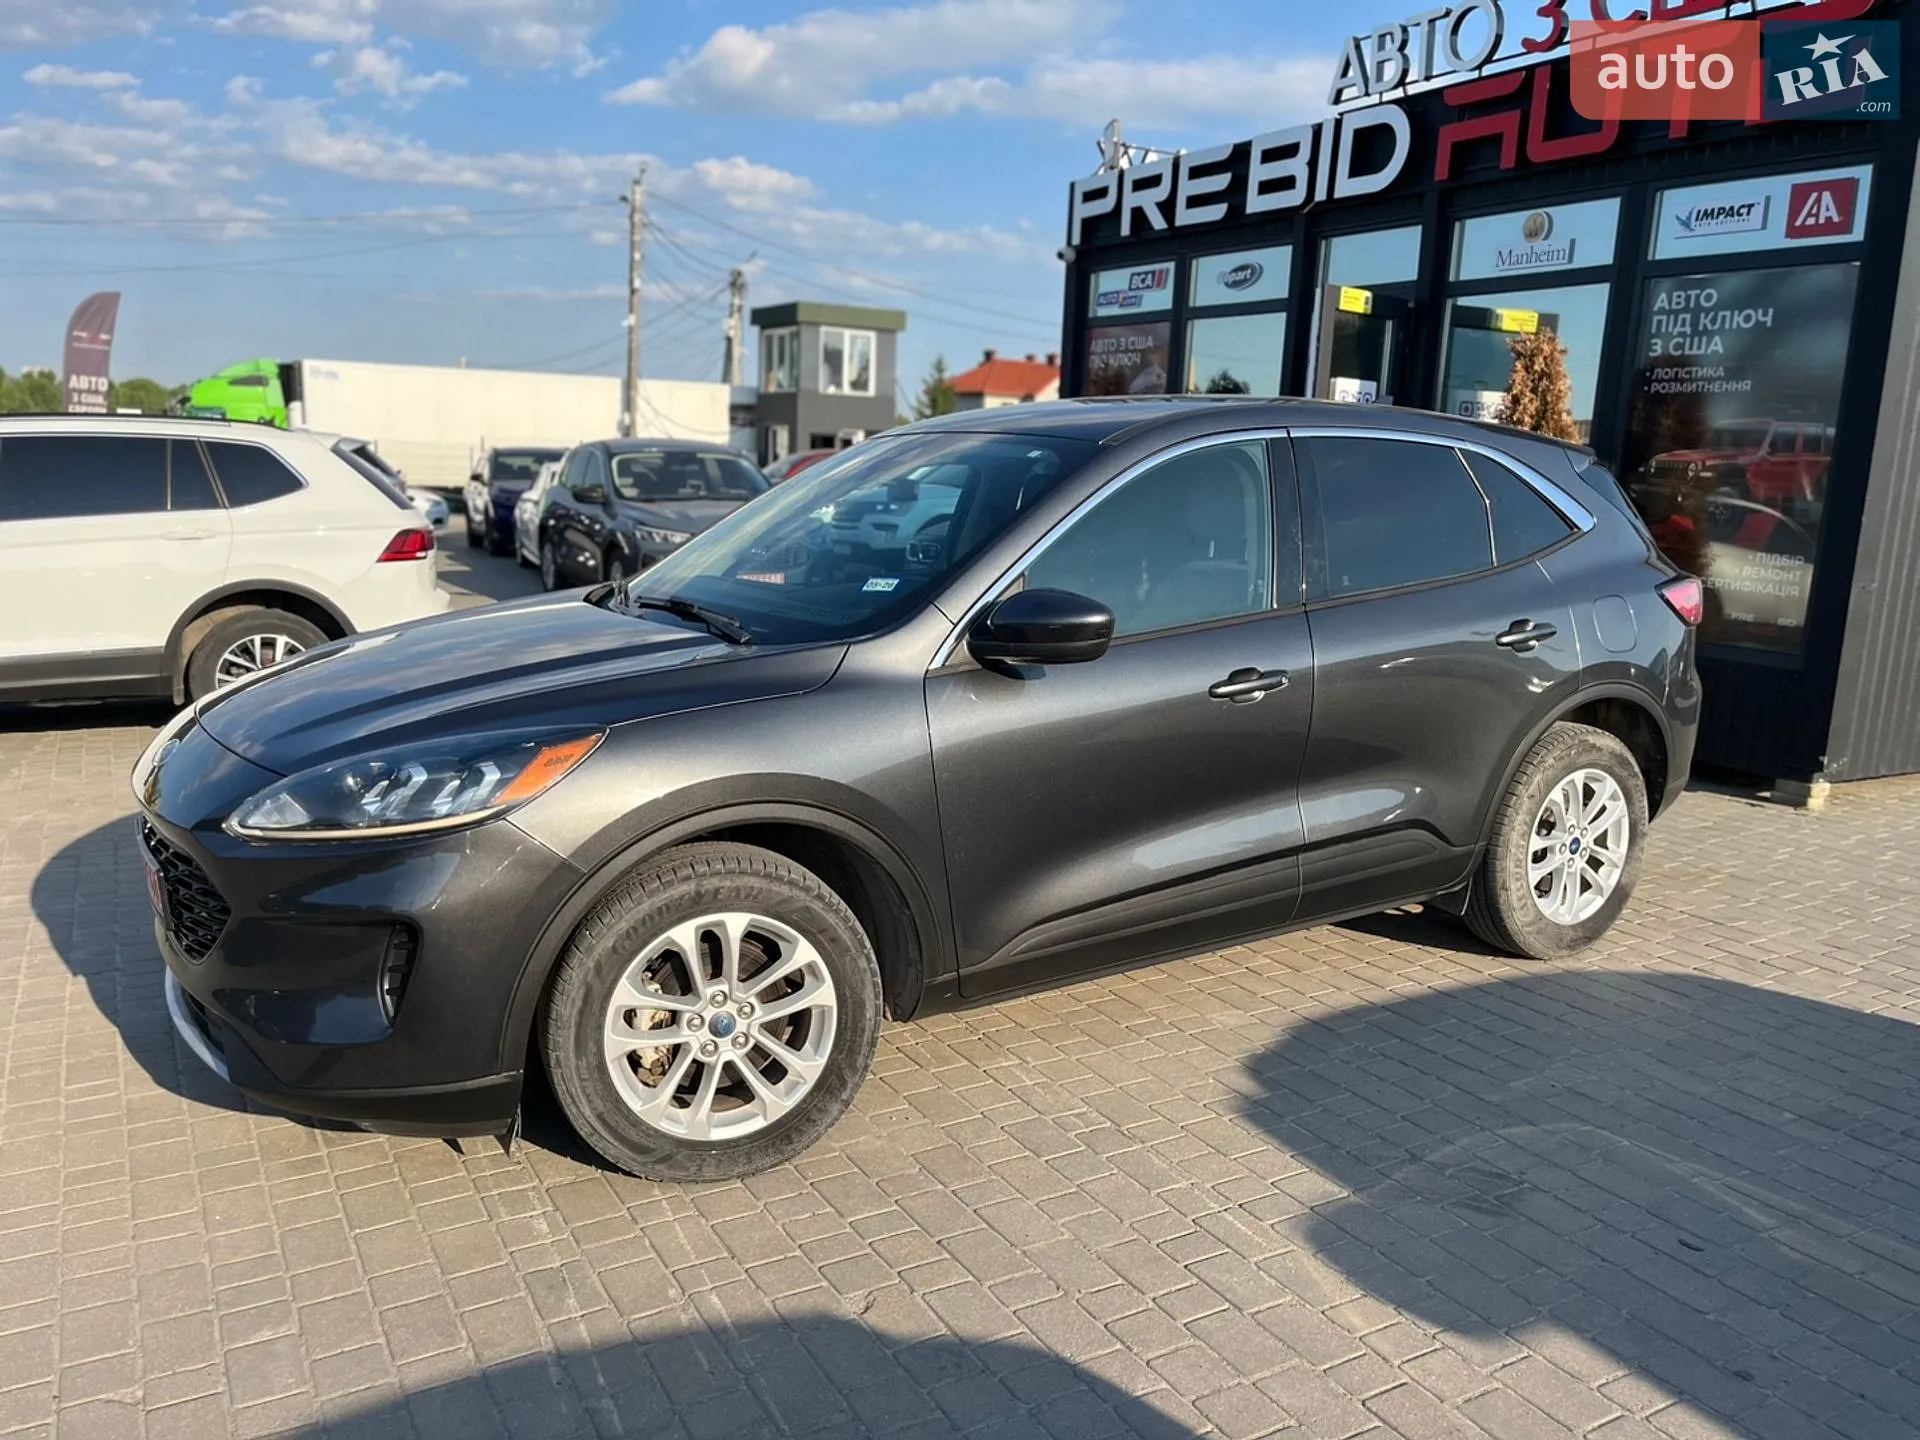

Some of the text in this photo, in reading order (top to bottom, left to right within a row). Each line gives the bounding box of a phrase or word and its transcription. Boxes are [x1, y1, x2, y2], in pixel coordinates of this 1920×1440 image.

[1328, 0, 1504, 105] АВТО
[1070, 103, 1411, 246] PREBID
[1694, 202, 1757, 223] IMPACT
[1495, 243, 1568, 268] Manheim
[1130, 273, 1153, 289] BCA
[1652, 288, 1719, 311] АВТО
[1651, 307, 1774, 336] ПІД КЛЮЧ
[1090, 338, 1118, 353] АВТО
[1127, 335, 1154, 350] США
[1648, 335, 1724, 357] З США
[68, 373, 109, 392] АВТО
[1651, 365, 1725, 380] ЛОГІСТИКА
[1650, 380, 1752, 394] РОЗМИТНЕННЯ
[1755, 551, 1806, 568] ПІДБІР
[1742, 565, 1804, 582] РЕМОНТ
